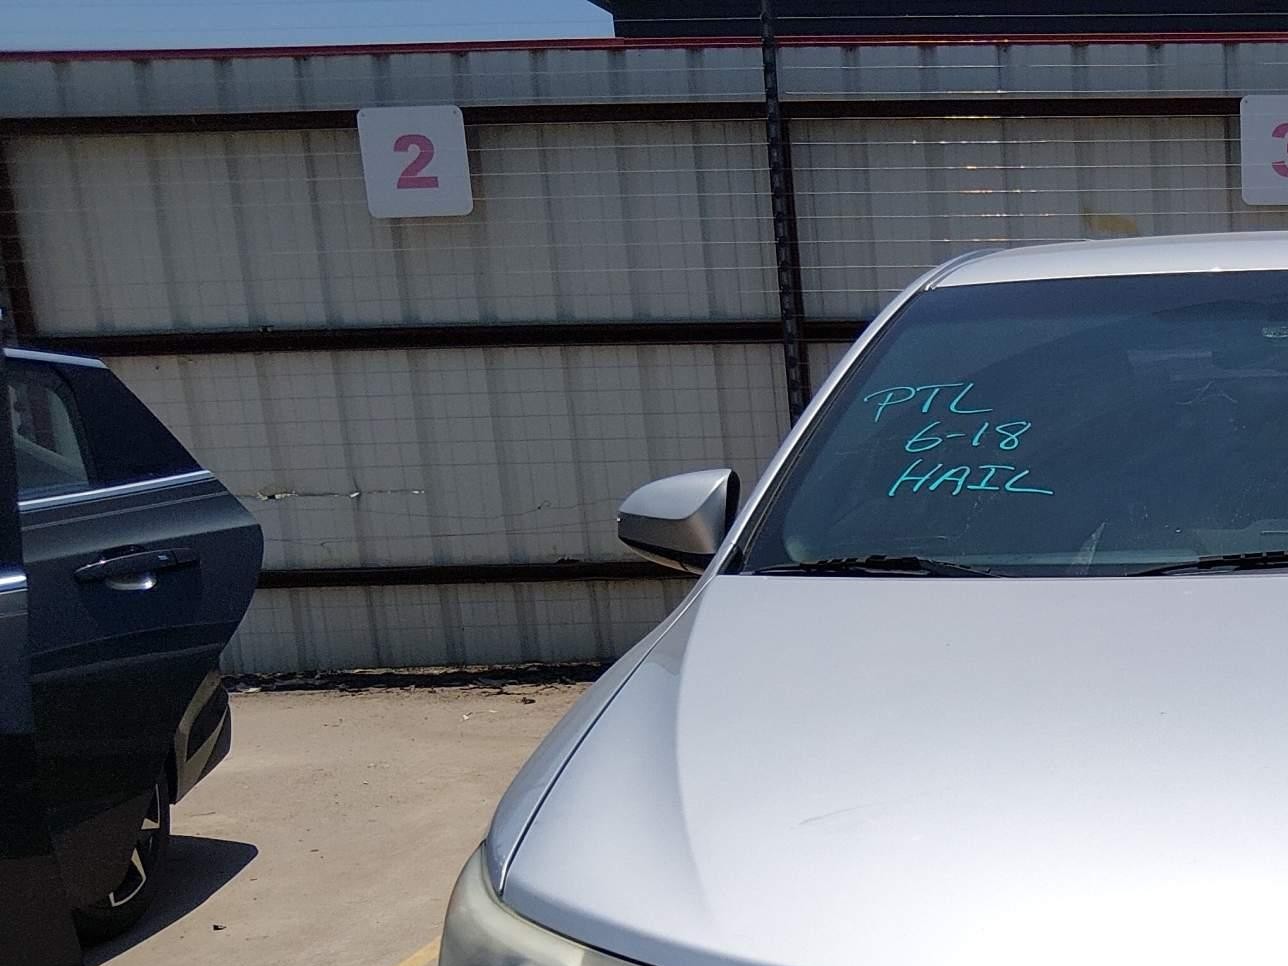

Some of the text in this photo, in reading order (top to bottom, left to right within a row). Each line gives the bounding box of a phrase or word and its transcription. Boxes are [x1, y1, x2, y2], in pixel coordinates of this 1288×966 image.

[393, 134, 439, 189] 2
[863, 382, 993, 423] PTL
[904, 421, 1032, 452] 6-18
[888, 458, 1054, 497] HAIL
